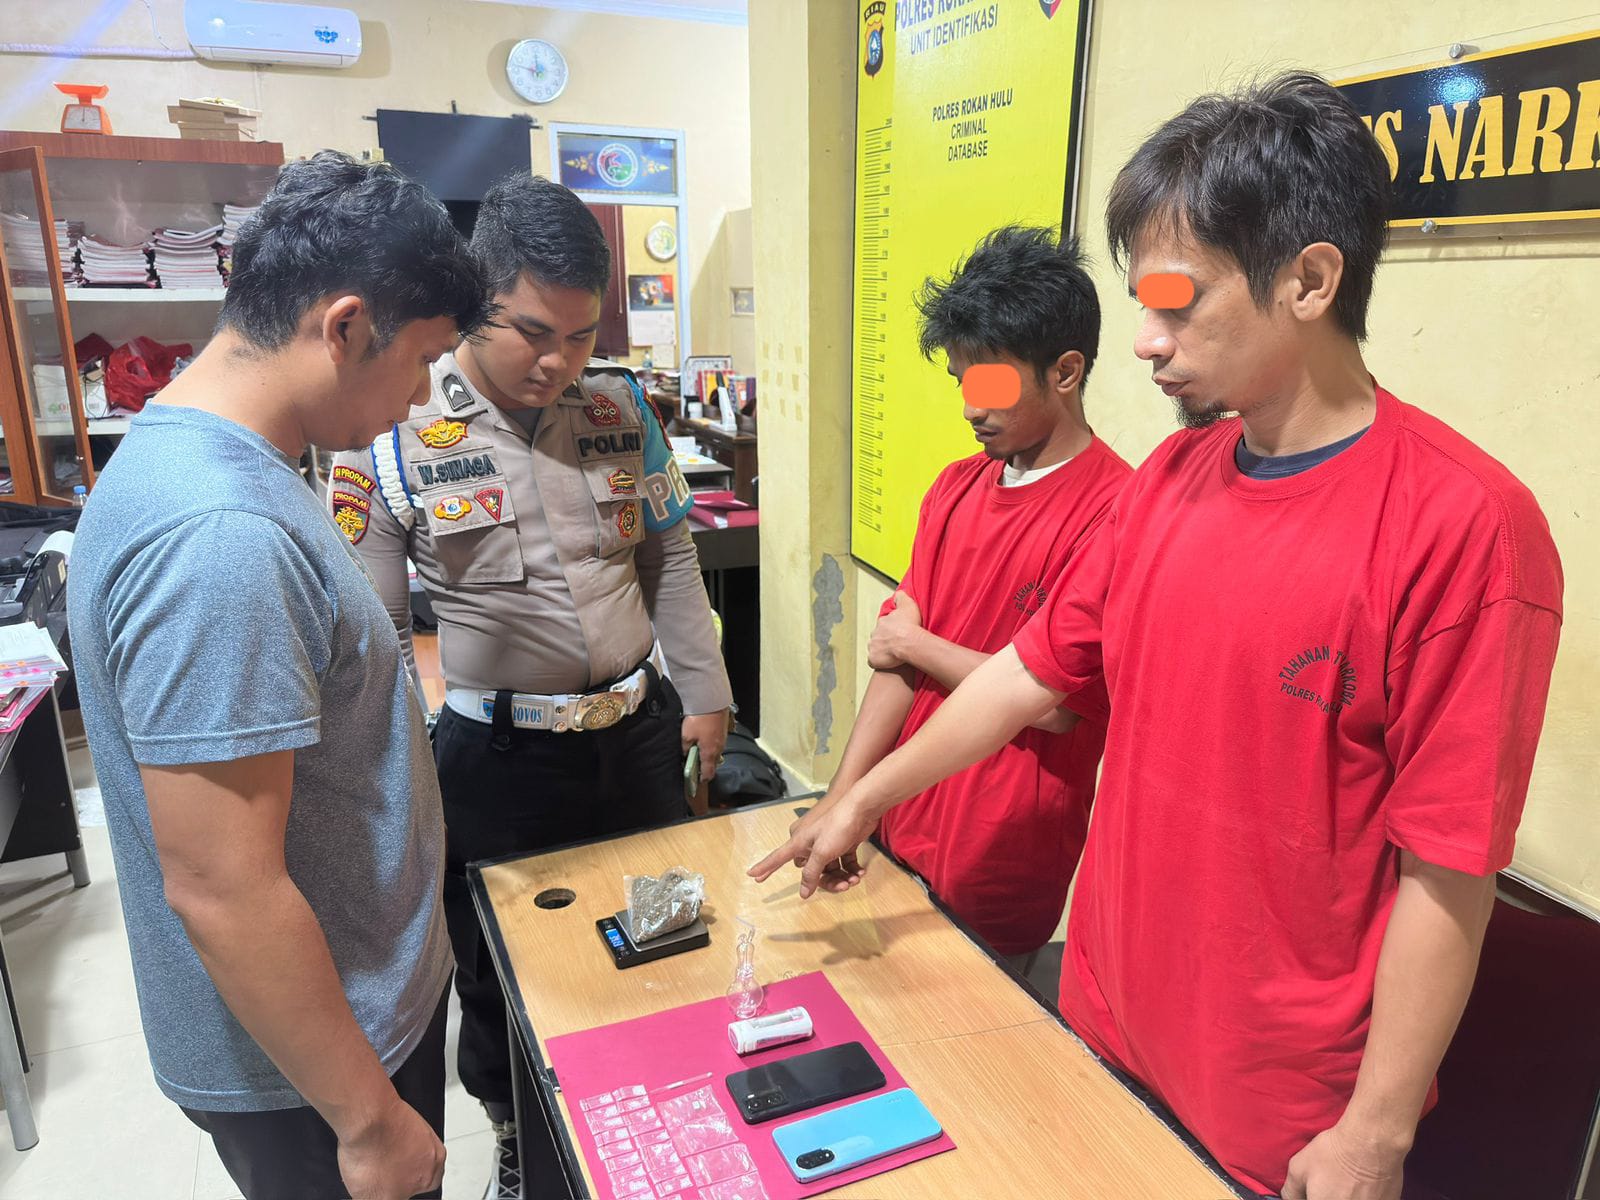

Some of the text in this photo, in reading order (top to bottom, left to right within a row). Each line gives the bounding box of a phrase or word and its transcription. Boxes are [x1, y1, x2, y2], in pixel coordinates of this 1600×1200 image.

[865, 3, 885, 18] RIAU
[911, 29, 931, 55] UNIT
[933, 4, 998, 47] IDENTIFIKASI
[932, 88, 1013, 122] POLRES ROKAN HULU
[951, 118, 988, 140] CRIMINAL
[948, 140, 988, 162] DATABASE
[578, 431, 641, 457] POLRI
[341, 468, 371, 489] PROPAM
[417, 454, 496, 485] W.SINAGA
[335, 493, 368, 508] PROPAM
[1279, 645, 1331, 681] TAHANAN
[1280, 682, 1316, 702] POLRES
